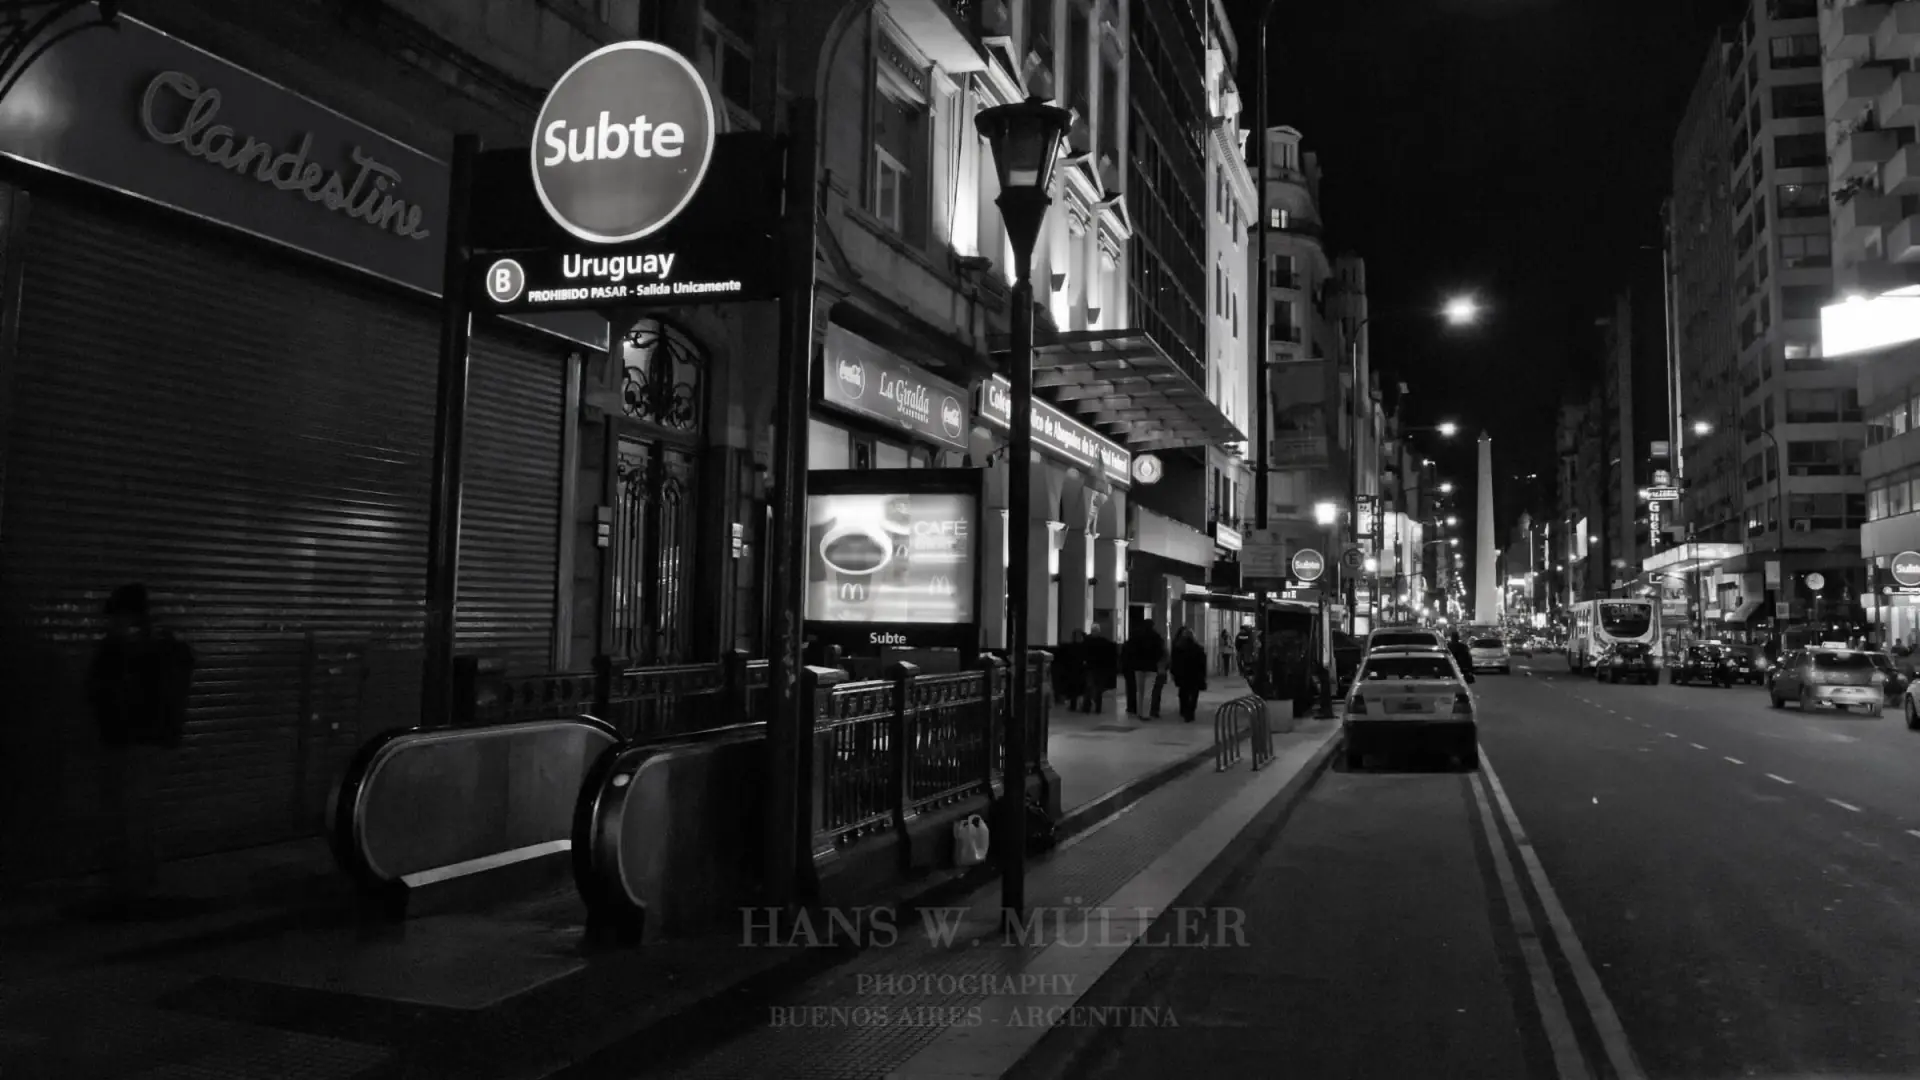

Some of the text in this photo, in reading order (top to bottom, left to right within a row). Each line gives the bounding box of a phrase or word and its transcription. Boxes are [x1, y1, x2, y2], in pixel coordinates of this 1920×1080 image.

[544, 111, 685, 167] Subte
[495, 268, 512, 293] B
[563, 253, 675, 282] Uruguay
[528, 288, 588, 302] PROHIBIDO
[591, 286, 627, 299] PASAR
[637, 283, 670, 296] Salida
[673, 279, 742, 294] Unicamente
[879, 372, 894, 399] La
[896, 379, 930, 415] Giralda
[989, 385, 1011, 420] Coleg
[914, 517, 968, 536] CAFÉ
[870, 632, 907, 644] Subte
